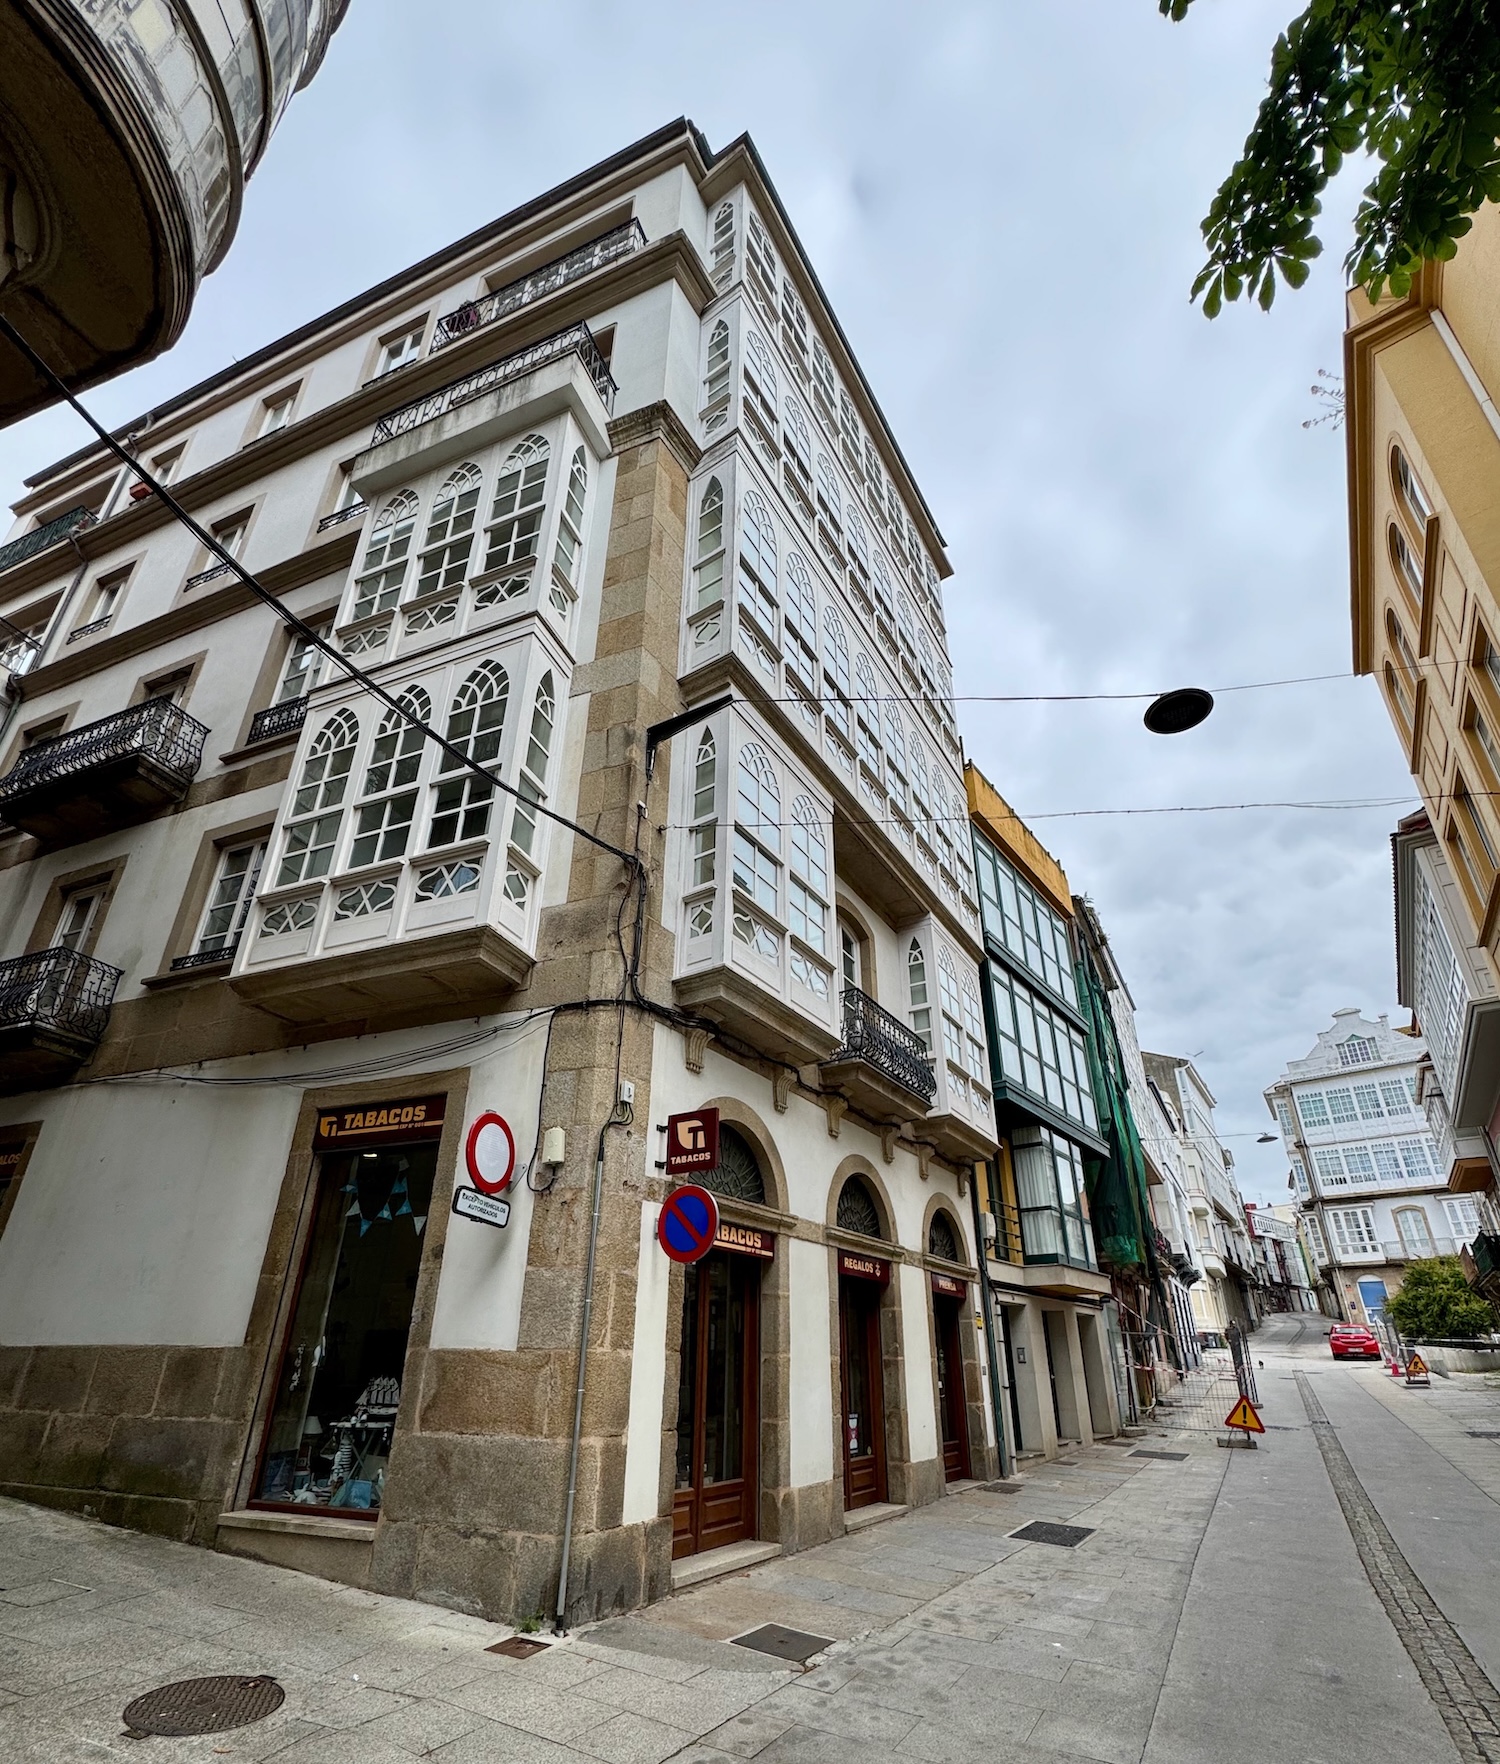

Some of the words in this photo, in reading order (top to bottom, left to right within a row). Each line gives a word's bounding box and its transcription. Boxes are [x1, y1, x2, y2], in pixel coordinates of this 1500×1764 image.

[343, 1104, 427, 1129] TABACOS
[670, 1152, 711, 1165] TABACOS
[462, 1192, 483, 1205] EXCEPTO
[467, 1203, 498, 1218] AUTORIZADOS
[844, 1256, 874, 1274] REGALOS
[938, 1279, 957, 1292] PRENSA
